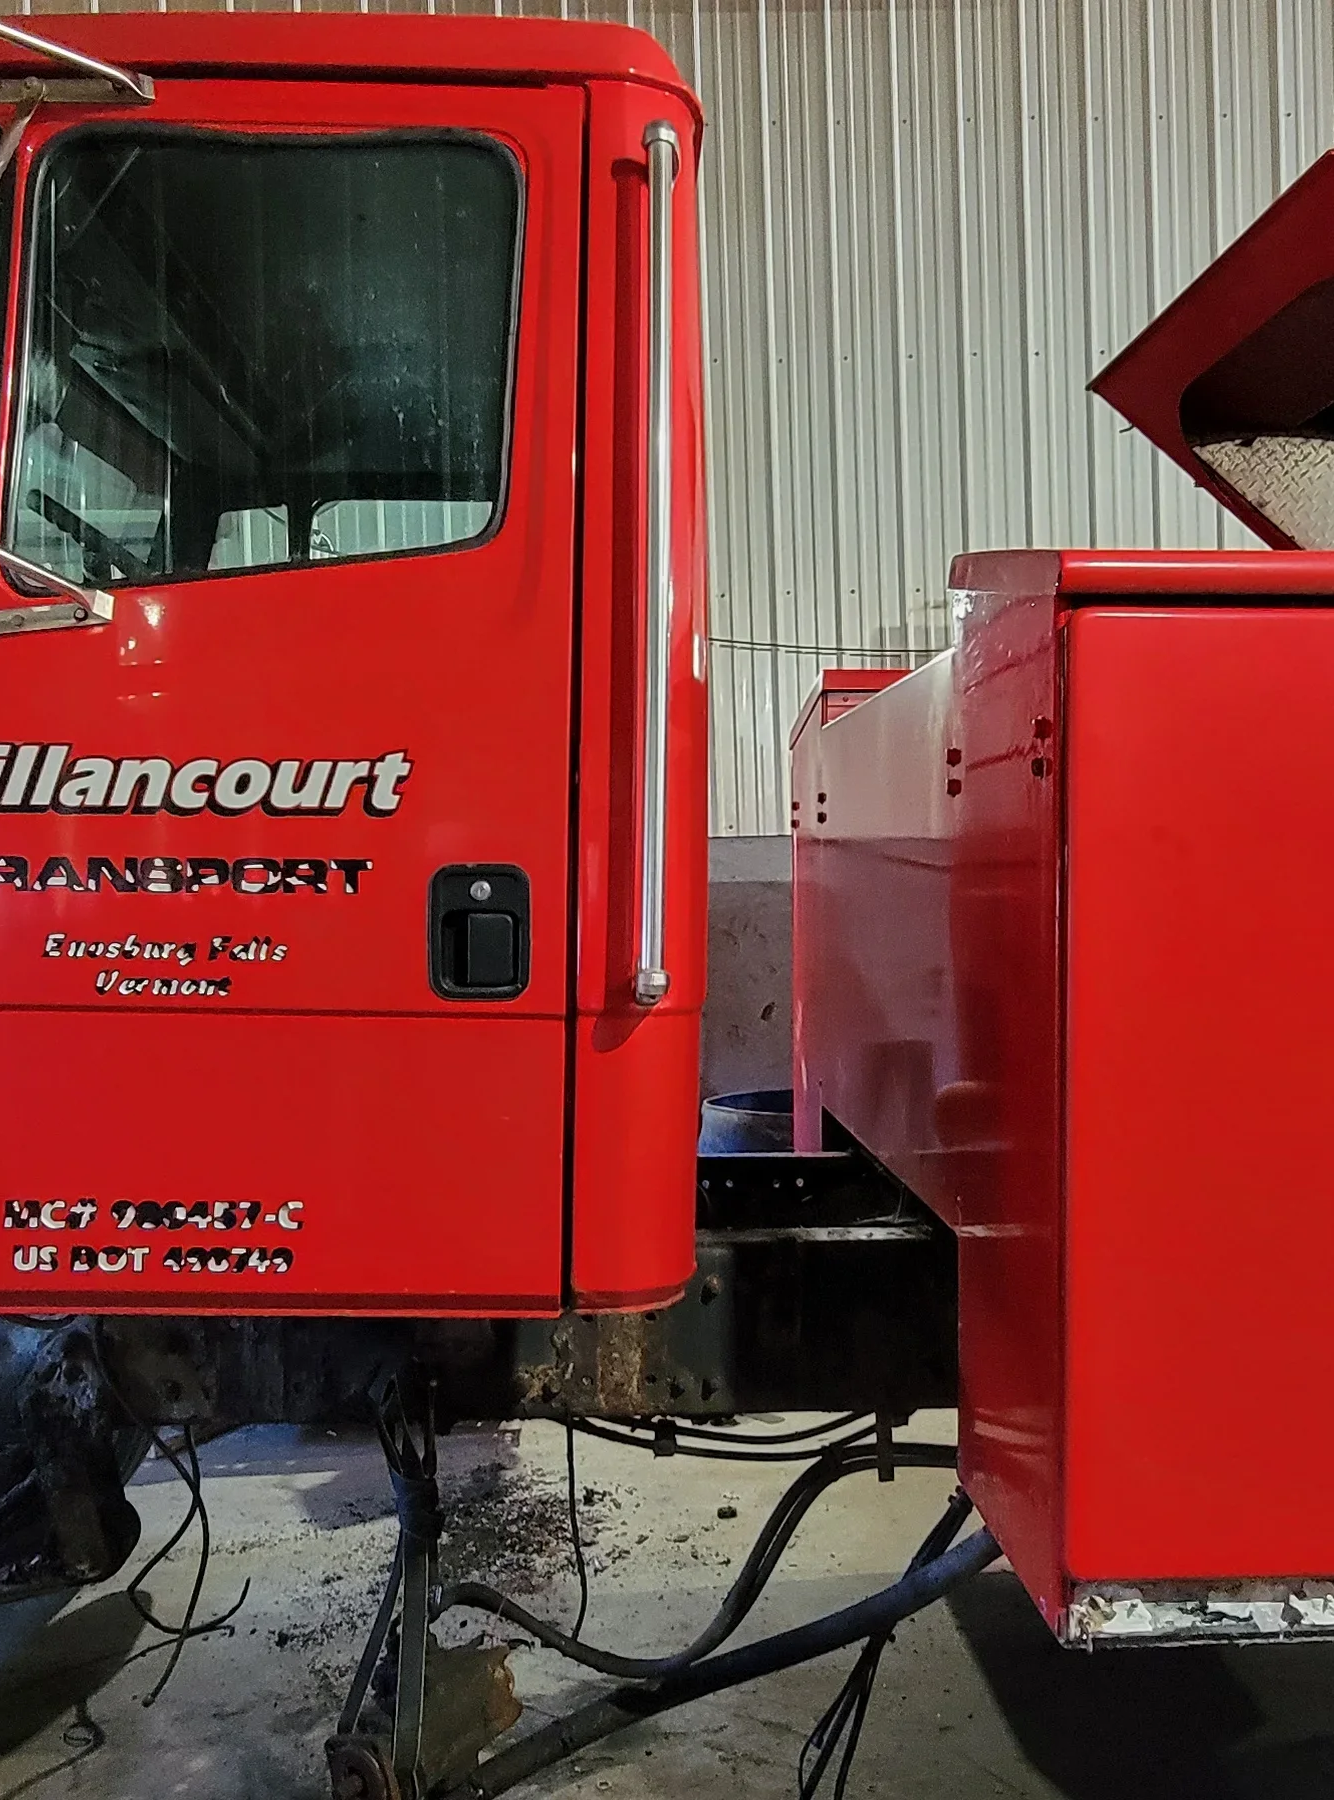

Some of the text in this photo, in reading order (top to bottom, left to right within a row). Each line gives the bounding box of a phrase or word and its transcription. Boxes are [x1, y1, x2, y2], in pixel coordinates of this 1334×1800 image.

[208, 935, 288, 962] Falls
[95, 969, 233, 997] Vermont
[2, 1198, 97, 1230] MC#
[12, 1245, 58, 1273] US
[70, 1245, 150, 1273] DOT
